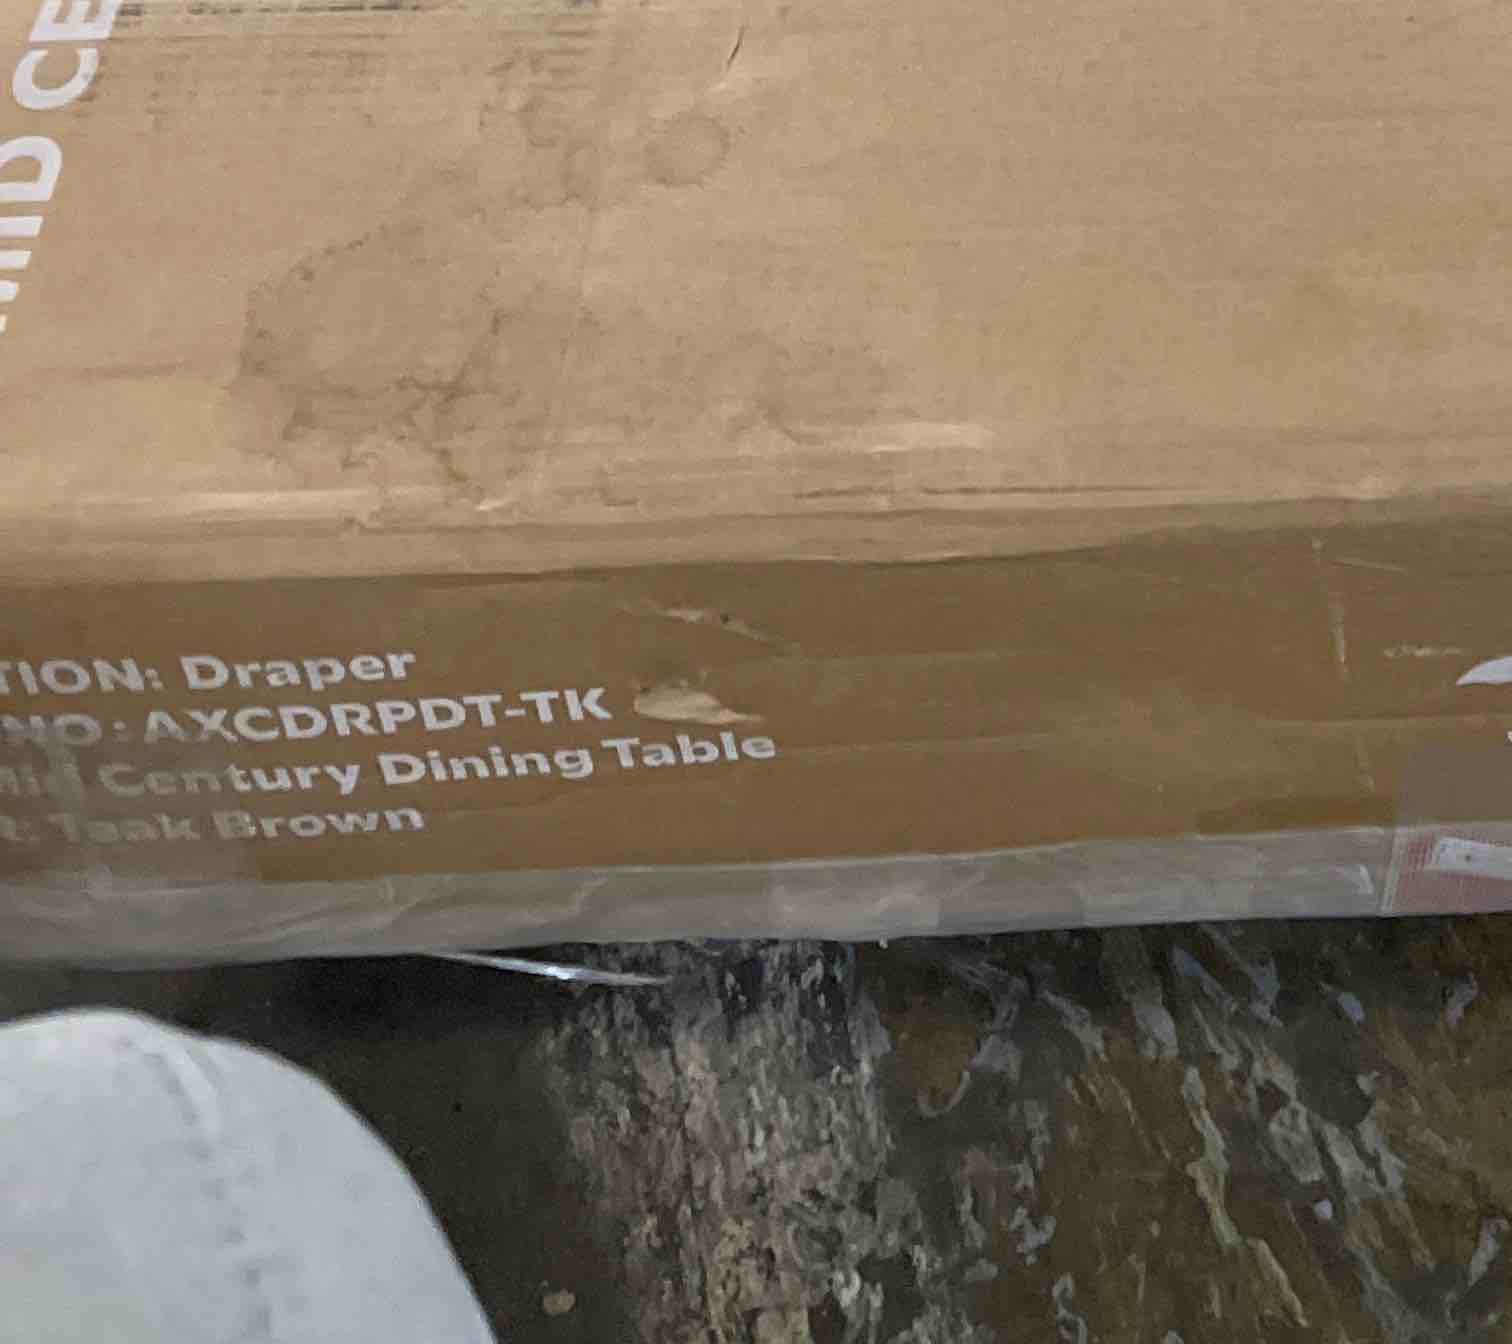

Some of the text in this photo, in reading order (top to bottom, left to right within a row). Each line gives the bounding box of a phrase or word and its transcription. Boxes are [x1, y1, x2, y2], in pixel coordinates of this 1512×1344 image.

[179, 652, 416, 693] Draper
[144, 687, 613, 745] AXCDRPDT-TK
[100, 761, 361, 797] Century
[378, 745, 594, 787] Dining
[600, 729, 778, 770] Table
[212, 805, 425, 843] Brown
